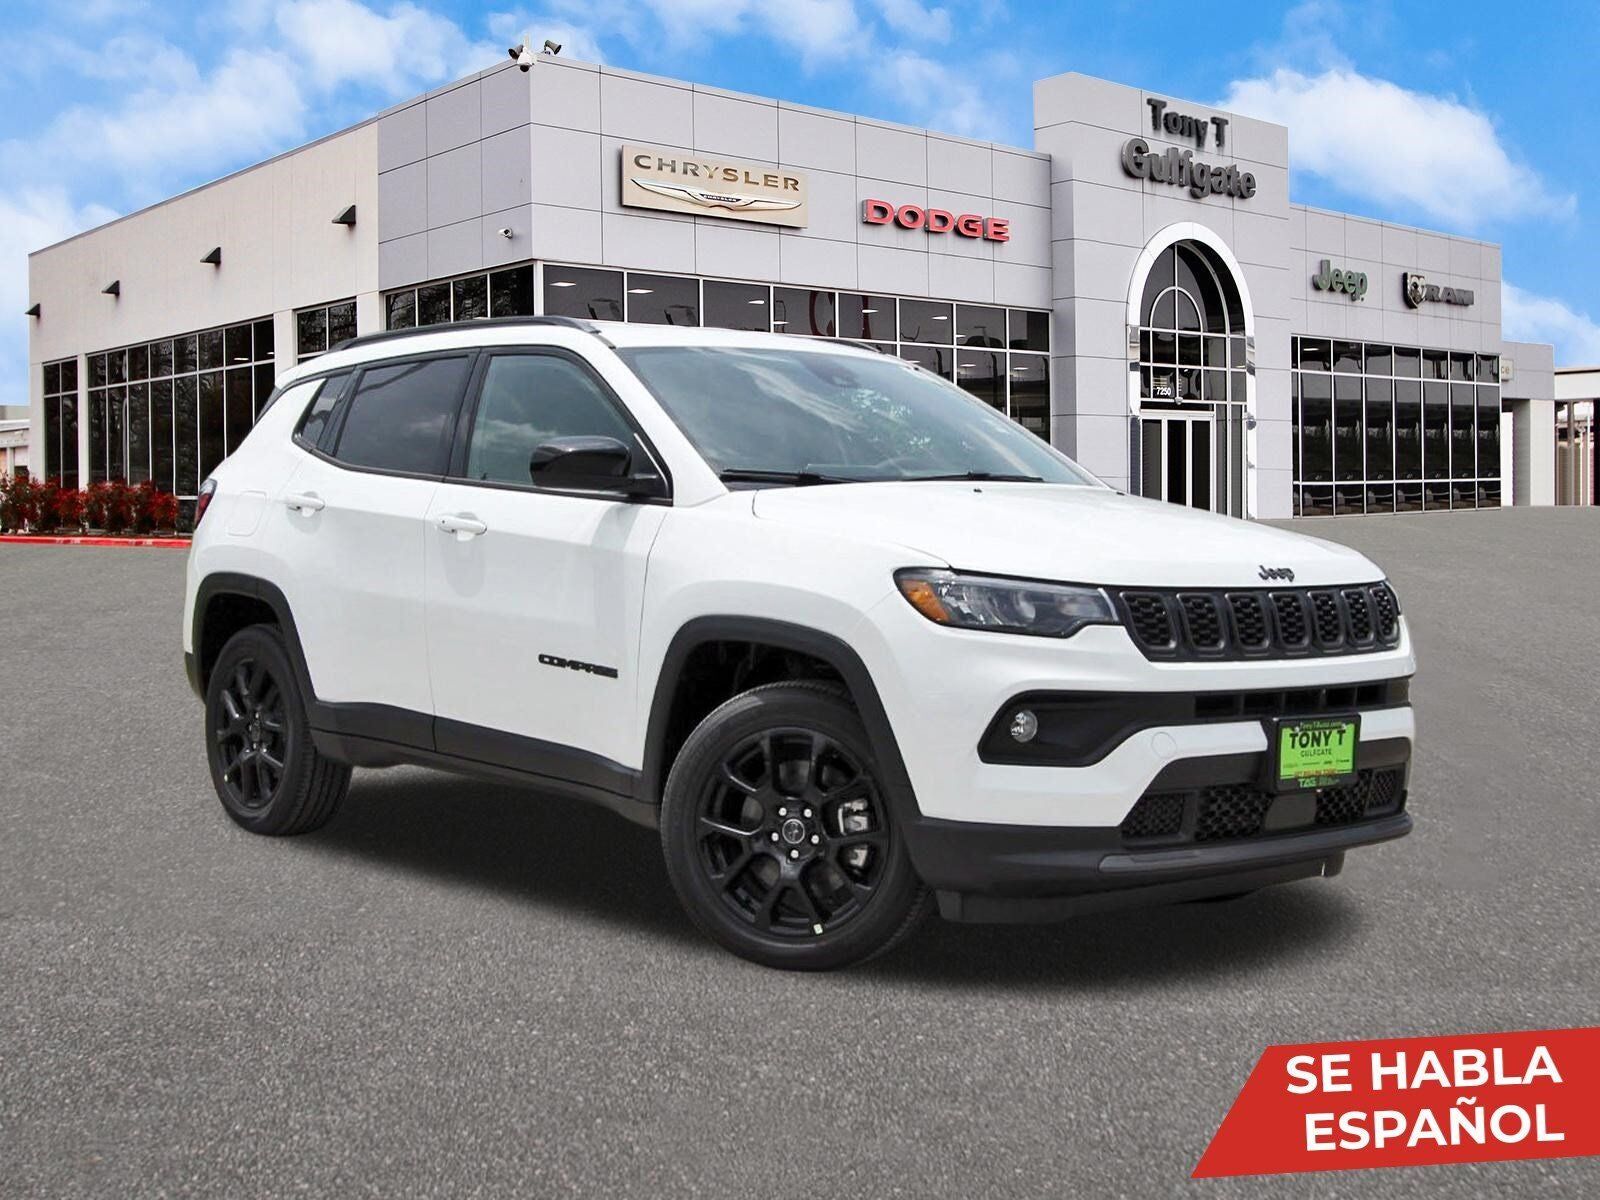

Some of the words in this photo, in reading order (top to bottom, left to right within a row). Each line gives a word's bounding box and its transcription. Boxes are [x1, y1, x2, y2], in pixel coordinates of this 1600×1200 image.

[1147, 98, 1208, 148] Tony
[1211, 117, 1229, 147] T
[634, 155, 800, 191] CHRYSLER
[1121, 138, 1256, 199] Gulfgate
[862, 199, 1010, 242] DODGE
[1312, 260, 1367, 301] Jeep
[1425, 284, 1474, 306] RAM
[1156, 387, 1172, 396] 7250
[1258, 565, 1295, 582] Jeep
[1289, 730, 1333, 749] TONY
[1337, 729, 1346, 746] T
